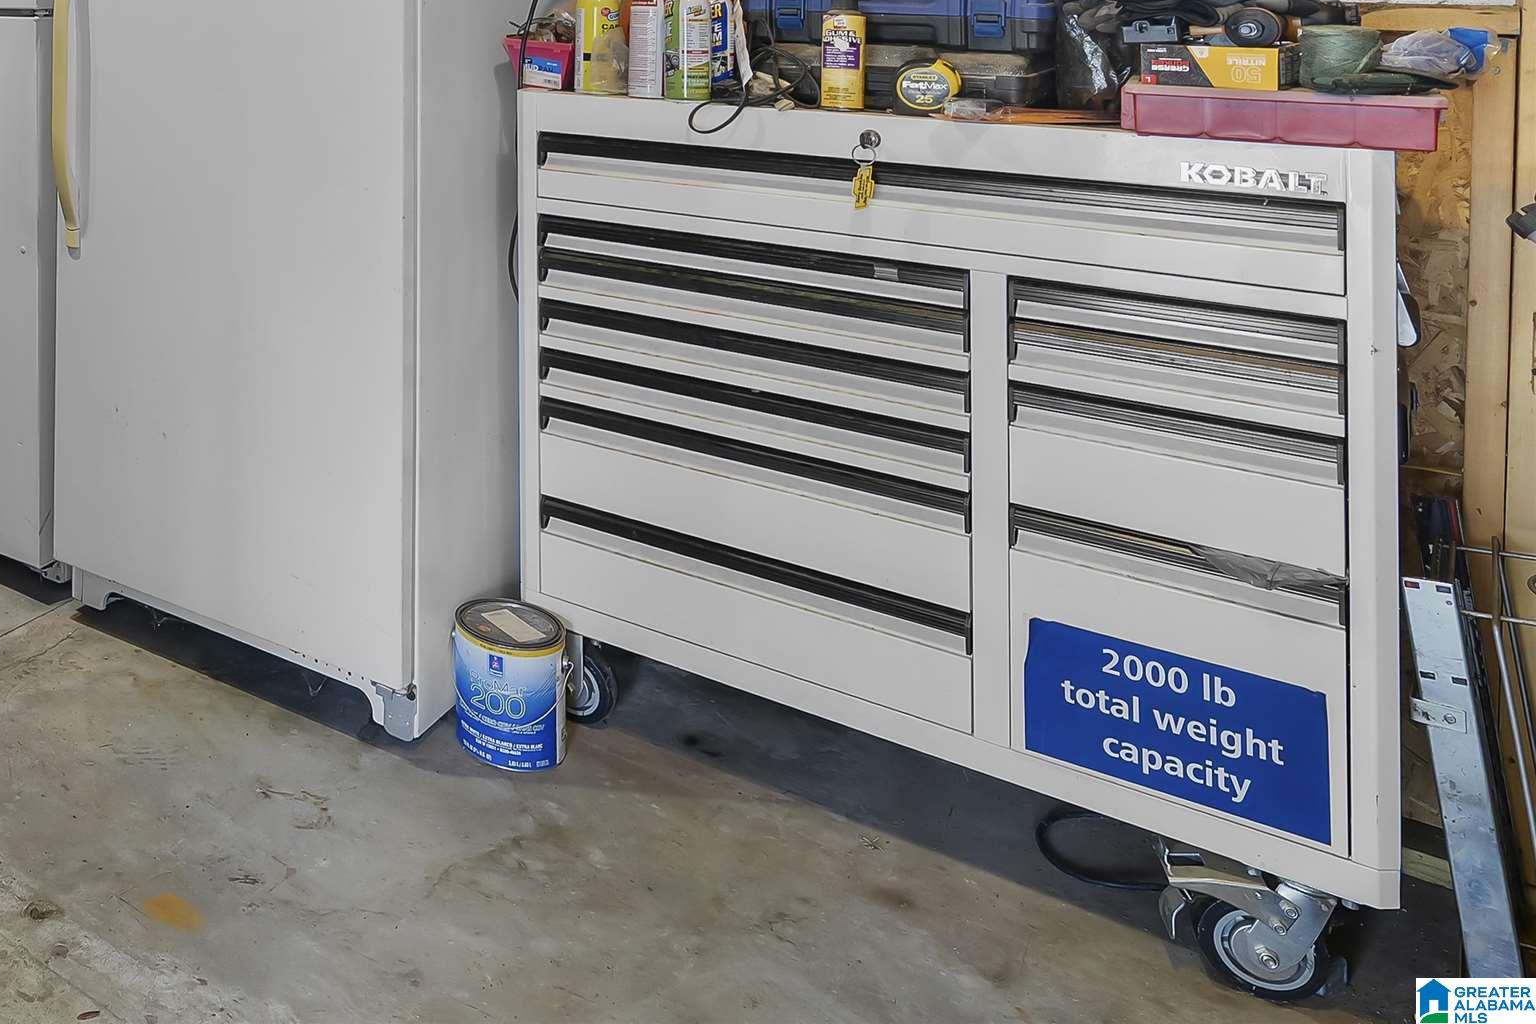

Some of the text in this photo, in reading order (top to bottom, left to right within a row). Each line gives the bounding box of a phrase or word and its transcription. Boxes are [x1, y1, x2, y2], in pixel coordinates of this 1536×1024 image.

[1226, 55, 1267, 66] NITRILE
[1231, 65, 1262, 84] 50
[915, 94, 933, 103] 25
[1179, 161, 1328, 196] KOBALT
[1101, 648, 1237, 707] 2000 lb
[470, 682, 526, 720] 200
[1060, 679, 1285, 766] total weight
[1102, 736, 1252, 803] capacity
